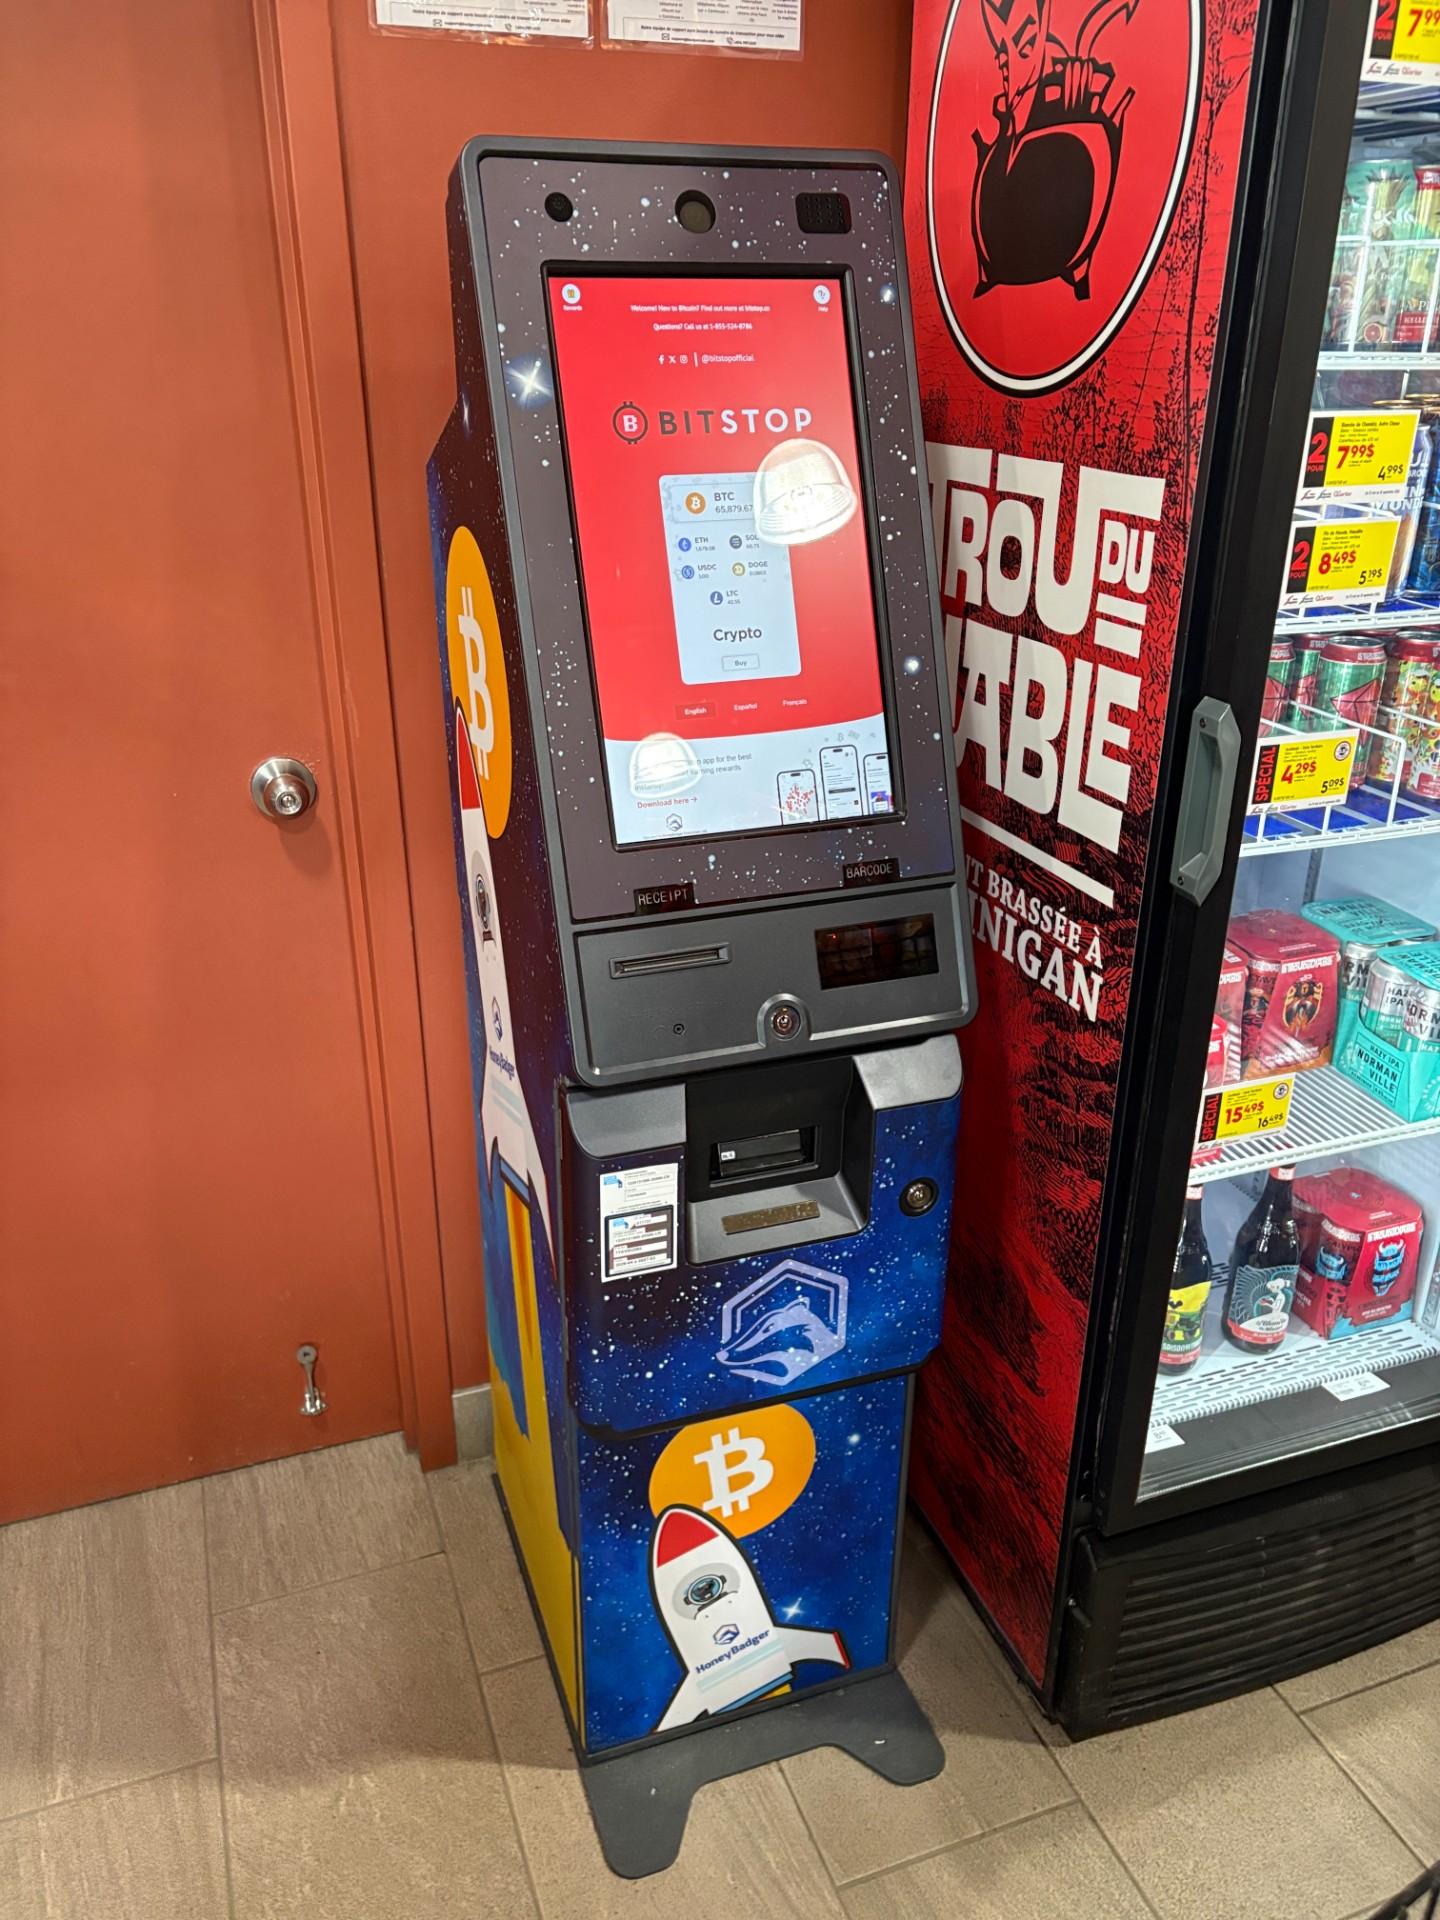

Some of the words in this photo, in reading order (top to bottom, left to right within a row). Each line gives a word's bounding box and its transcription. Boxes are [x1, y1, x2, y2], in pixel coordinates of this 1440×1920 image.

[653, 323, 682, 331] Questions?
[702, 353, 754, 363] @bitstopofficial
[659, 408, 812, 435] BITSTOP
[1308, 432, 1328, 463] 2
[1307, 464, 1324, 472] POUR
[714, 492, 735, 502] BTC
[1099, 519, 1156, 594] DU
[1291, 540, 1311, 571] 2
[713, 627, 763, 642] Crypto
[684, 707, 707, 715] English
[733, 703, 758, 711] Español
[716, 755, 725, 763] for
[716, 765, 742, 773] rewards
[637, 799, 672, 809] Download
[674, 797, 689, 805] here
[846, 862, 894, 879] BARCODE
[638, 889, 689, 905] RECEIPT
[987, 868, 1082, 954] BRASSÉE
[1085, 926, 1103, 969] À
[1370, 1044, 1387, 1059] HAZY
[1388, 1056, 1400, 1068] IPA
[1357, 1048, 1398, 1082] NORMAN
[1369, 1068, 1395, 1093] VILLE
[695, 1629, 770, 1674] HoneyBadger
